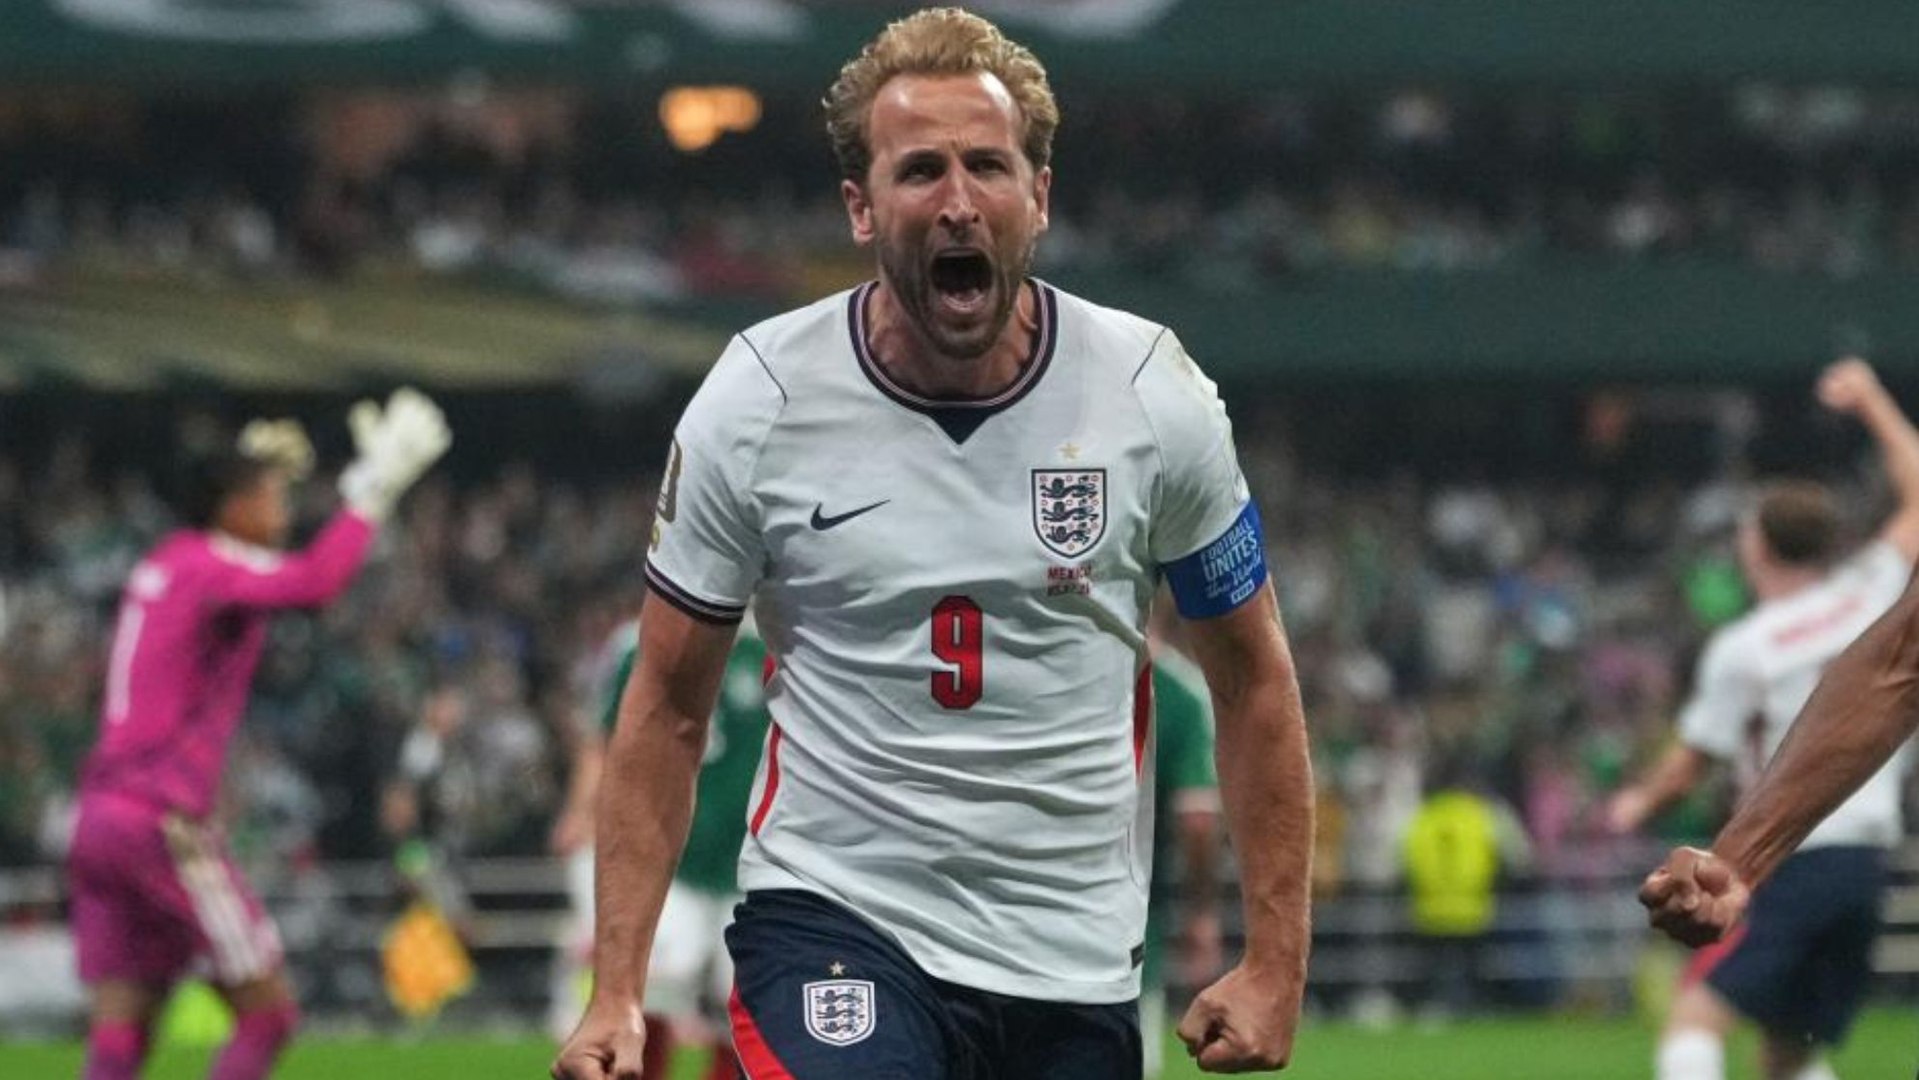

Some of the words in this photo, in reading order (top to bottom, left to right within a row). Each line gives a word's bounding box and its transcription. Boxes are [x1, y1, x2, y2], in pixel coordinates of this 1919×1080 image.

[1201, 517, 1255, 564] FOOTBALL
[1203, 530, 1257, 581] UNITES
[931, 595, 983, 710] 9
